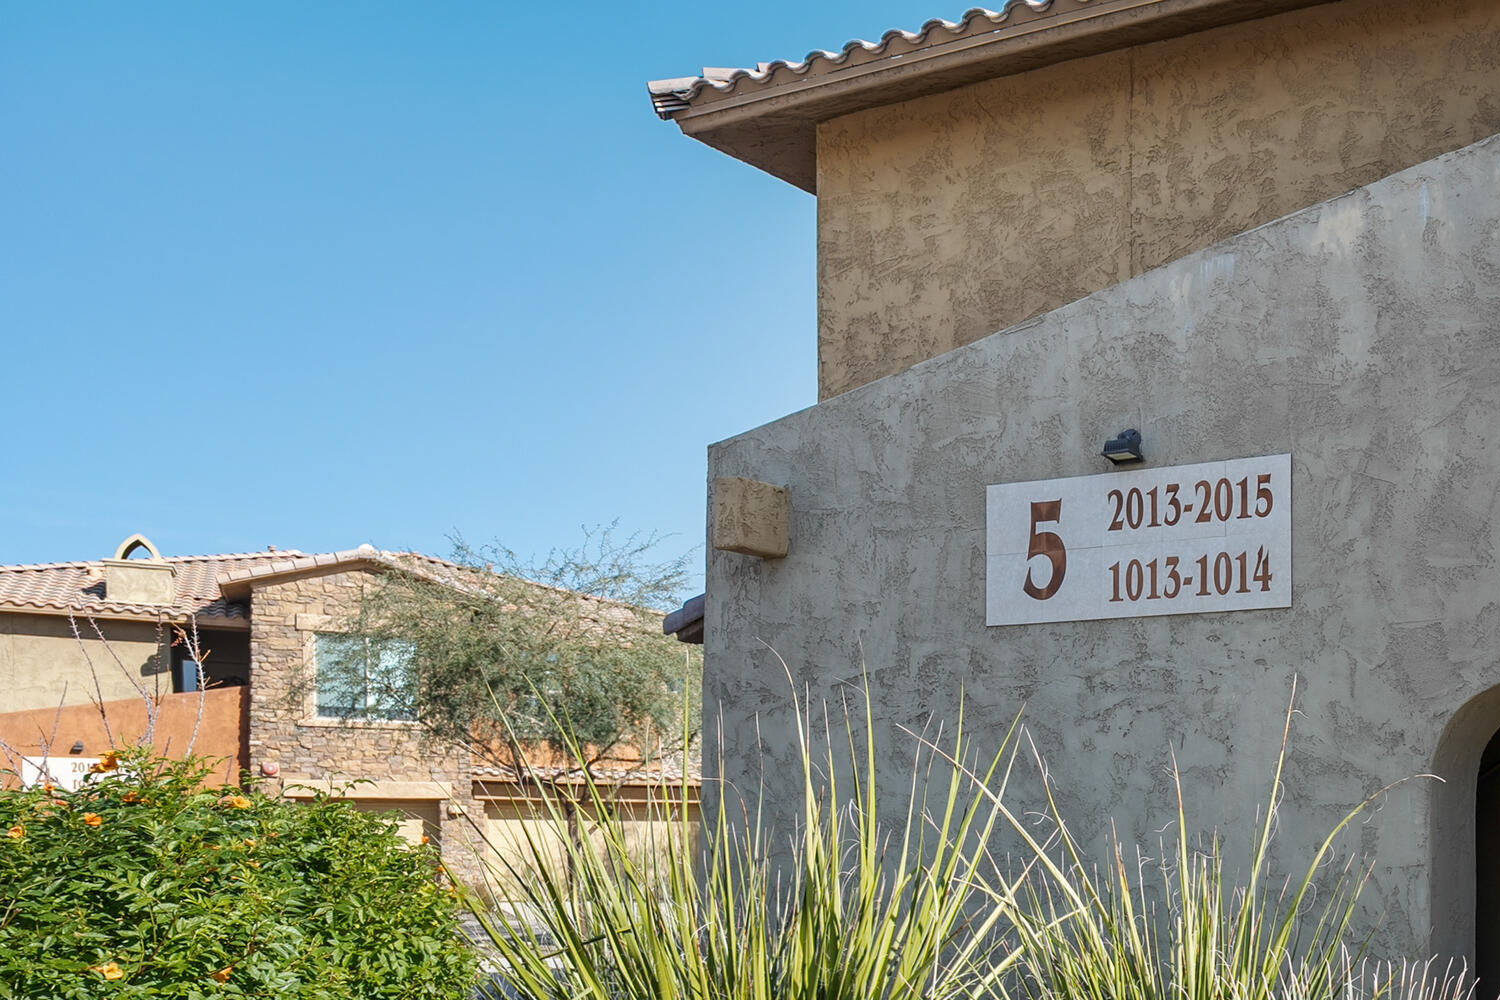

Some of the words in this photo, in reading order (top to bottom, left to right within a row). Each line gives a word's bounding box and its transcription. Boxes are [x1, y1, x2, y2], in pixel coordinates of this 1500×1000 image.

[1107, 473, 1273, 531] 2013-2015
[1023, 498, 1067, 600] 5
[1108, 544, 1273, 602] 1013-1014
